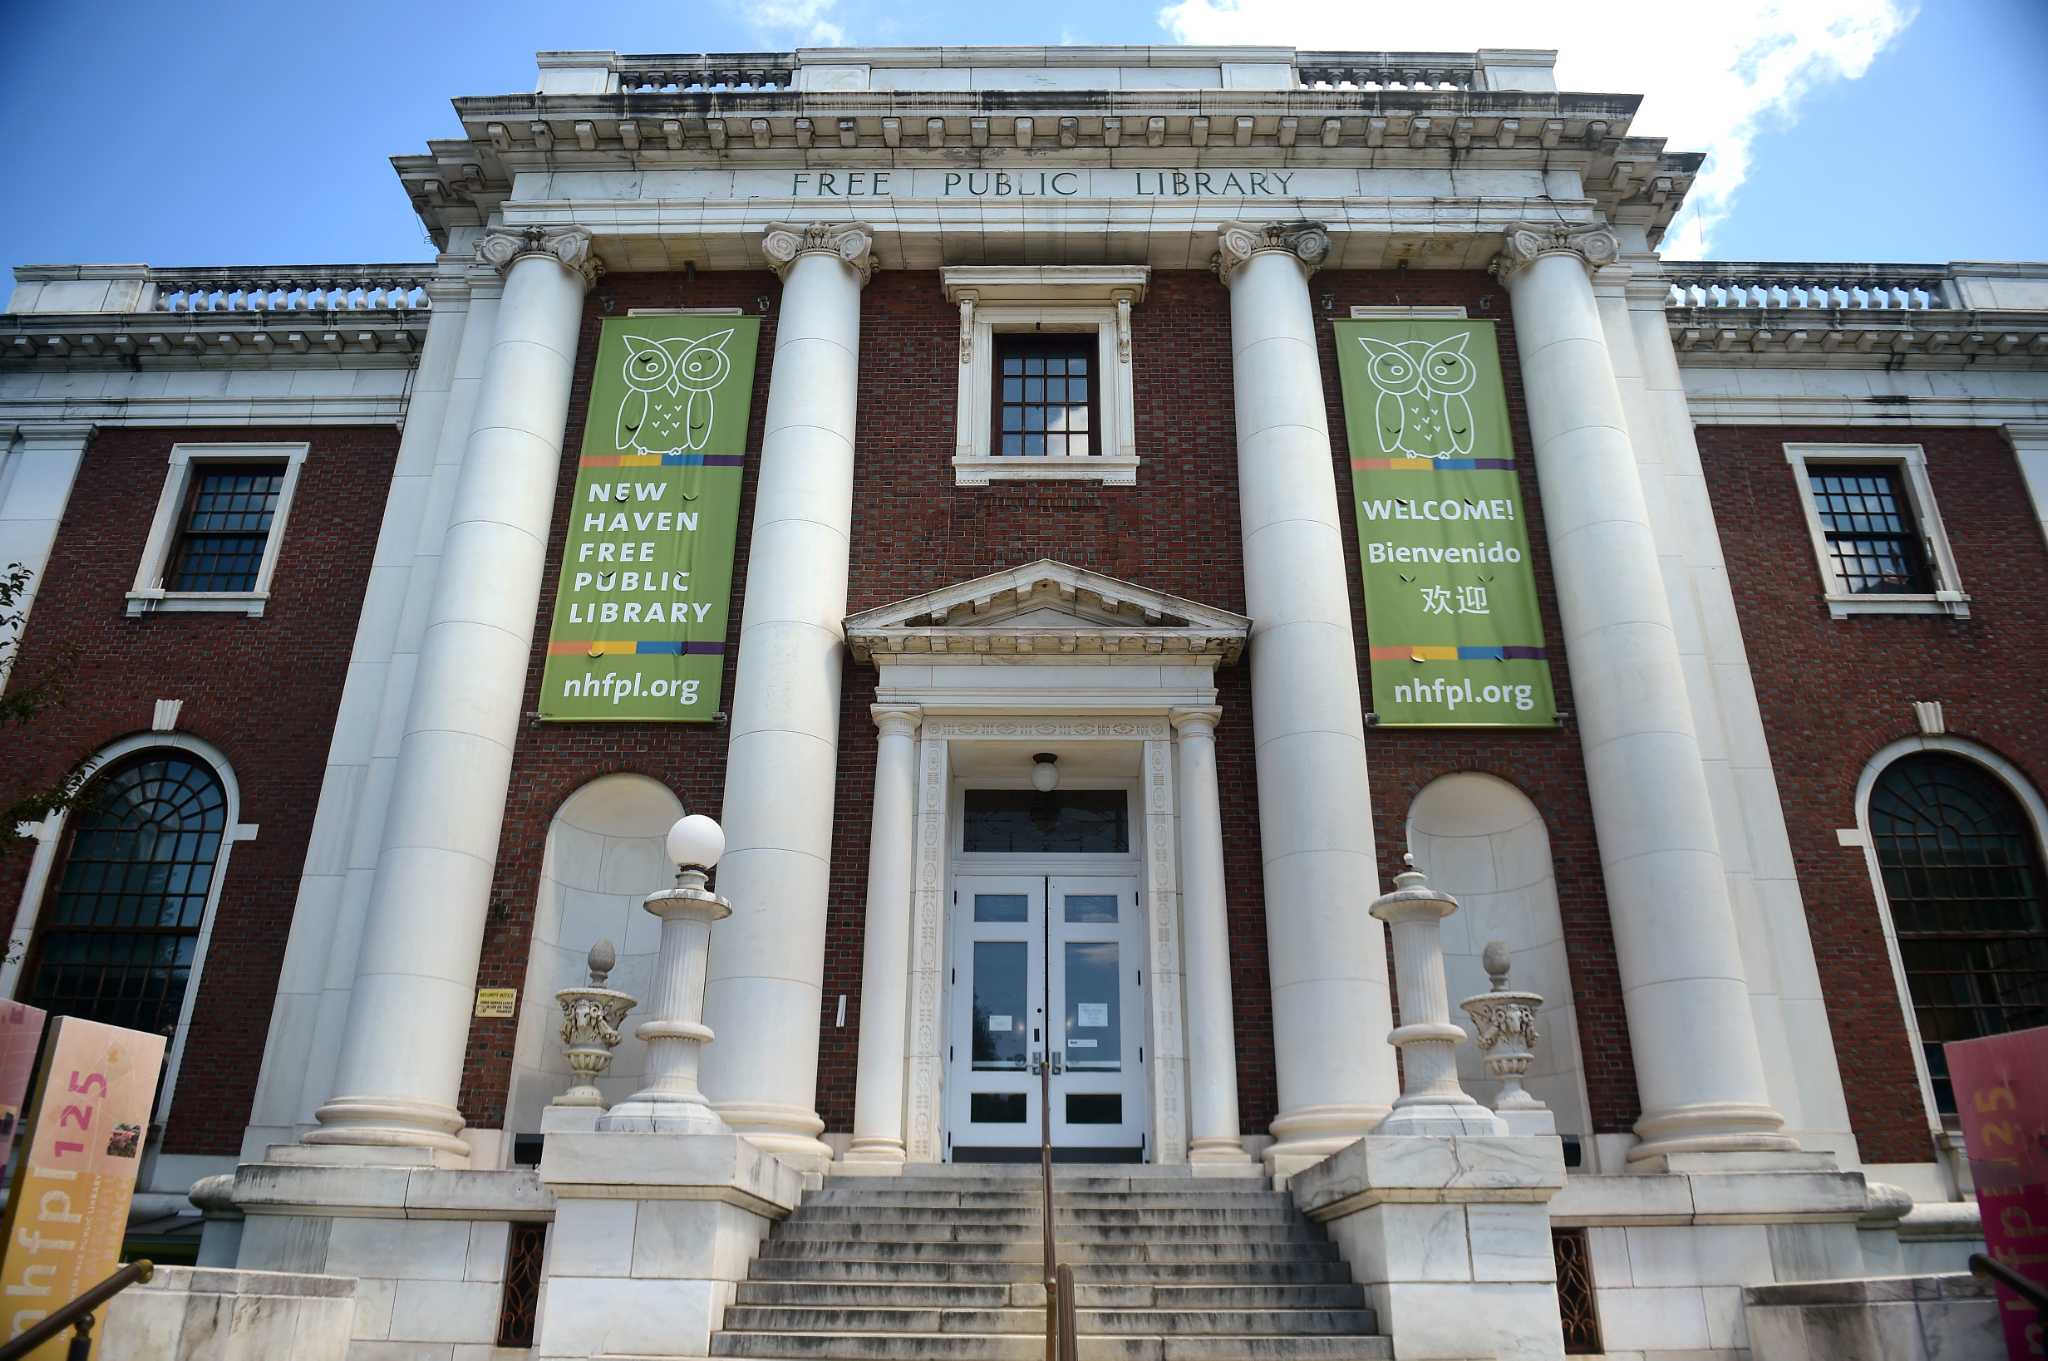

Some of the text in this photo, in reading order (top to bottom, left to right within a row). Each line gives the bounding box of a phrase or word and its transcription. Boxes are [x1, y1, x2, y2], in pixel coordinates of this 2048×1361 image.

[792, 172, 1295, 196] FREE PUBLIC LIBRARY
[588, 482, 667, 503] NEW
[583, 511, 699, 532] HAVEN
[1362, 499, 1514, 521] WELCOME!
[578, 541, 656, 563] FREE
[1368, 540, 1521, 564] Bienvenido
[574, 570, 690, 592] PUBLIC
[1420, 584, 1490, 615] 欢迎
[569, 602, 713, 624] LIBRARY
[563, 671, 700, 705] nhfpl.org
[1394, 677, 1534, 711] nhfpl.org
[54, 1070, 108, 1158] 125
